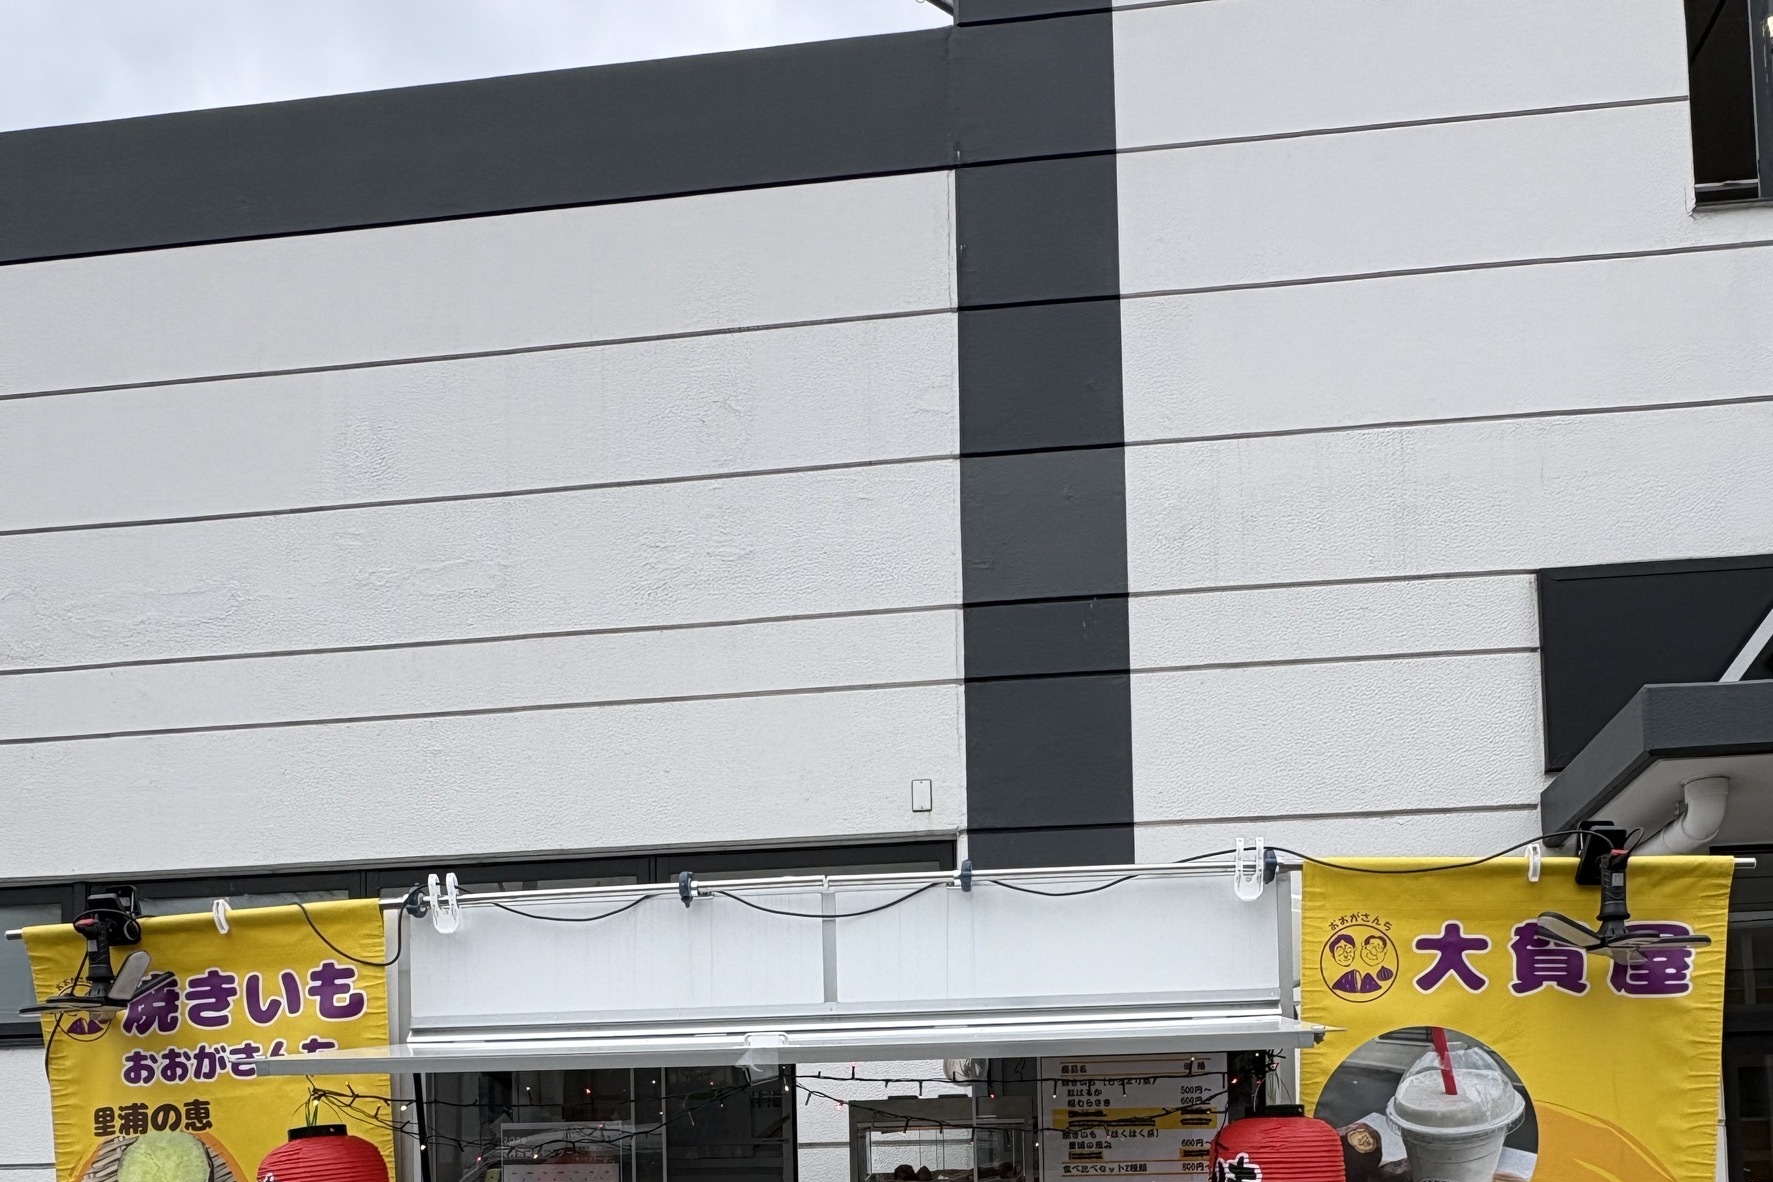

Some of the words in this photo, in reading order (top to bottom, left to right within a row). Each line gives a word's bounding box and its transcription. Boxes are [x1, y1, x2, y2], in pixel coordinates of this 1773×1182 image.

[1328, 912, 1392, 931] おおがさんち
[1415, 922, 1693, 994] 大賀屋
[122, 961, 366, 1035] 焼きいも
[94, 1099, 213, 1137] 里浦の恵
